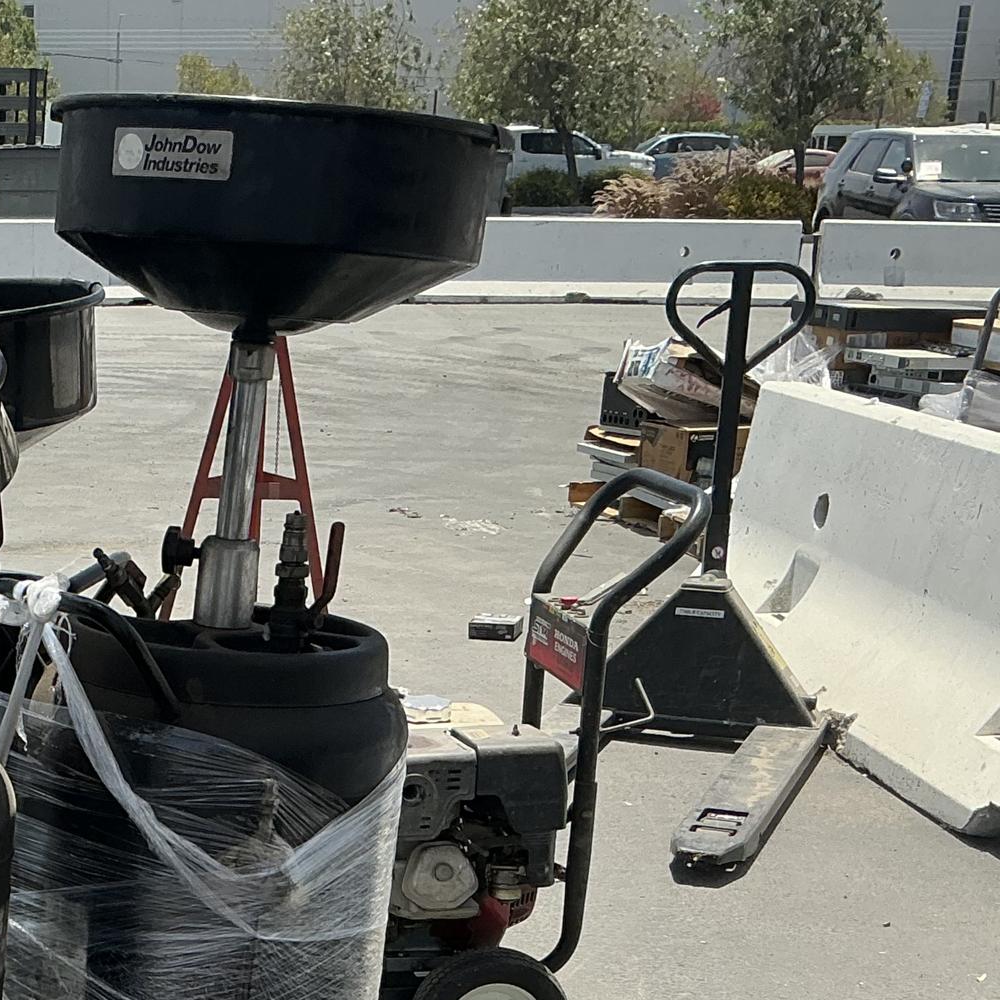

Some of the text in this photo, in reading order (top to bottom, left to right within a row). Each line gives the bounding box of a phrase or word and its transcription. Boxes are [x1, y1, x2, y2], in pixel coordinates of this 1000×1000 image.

[144, 133, 222, 155] JohnDow
[143, 152, 219, 174] Industries
[553, 628, 579, 652] HONDA
[553, 640, 577, 664] ENGINES
